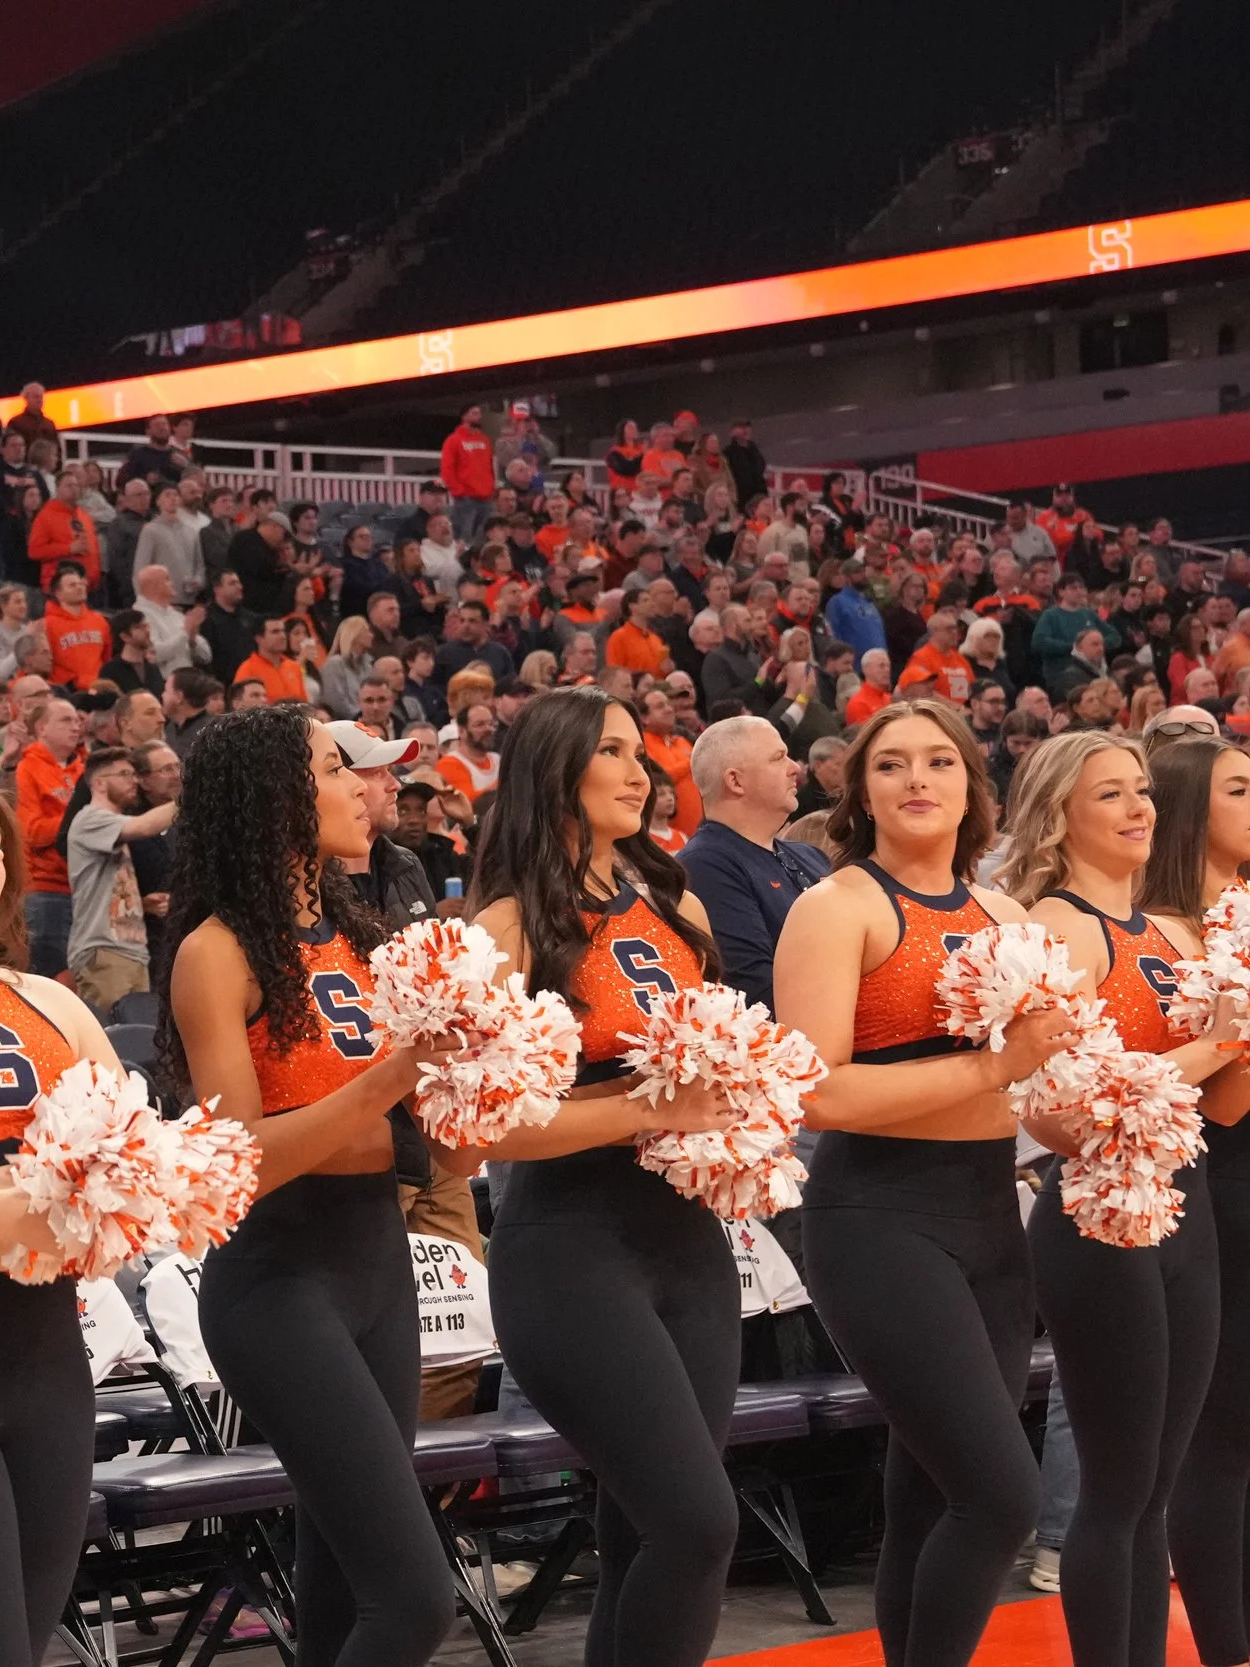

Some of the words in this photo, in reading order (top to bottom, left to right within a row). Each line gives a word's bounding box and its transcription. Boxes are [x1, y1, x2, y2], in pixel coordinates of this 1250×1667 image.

[610, 937, 678, 1018] S
[309, 970, 383, 1060] S
[436, 1315, 442, 1332] A
[446, 1312, 465, 1331] 113
[443, 1293, 474, 1304] SENSING
